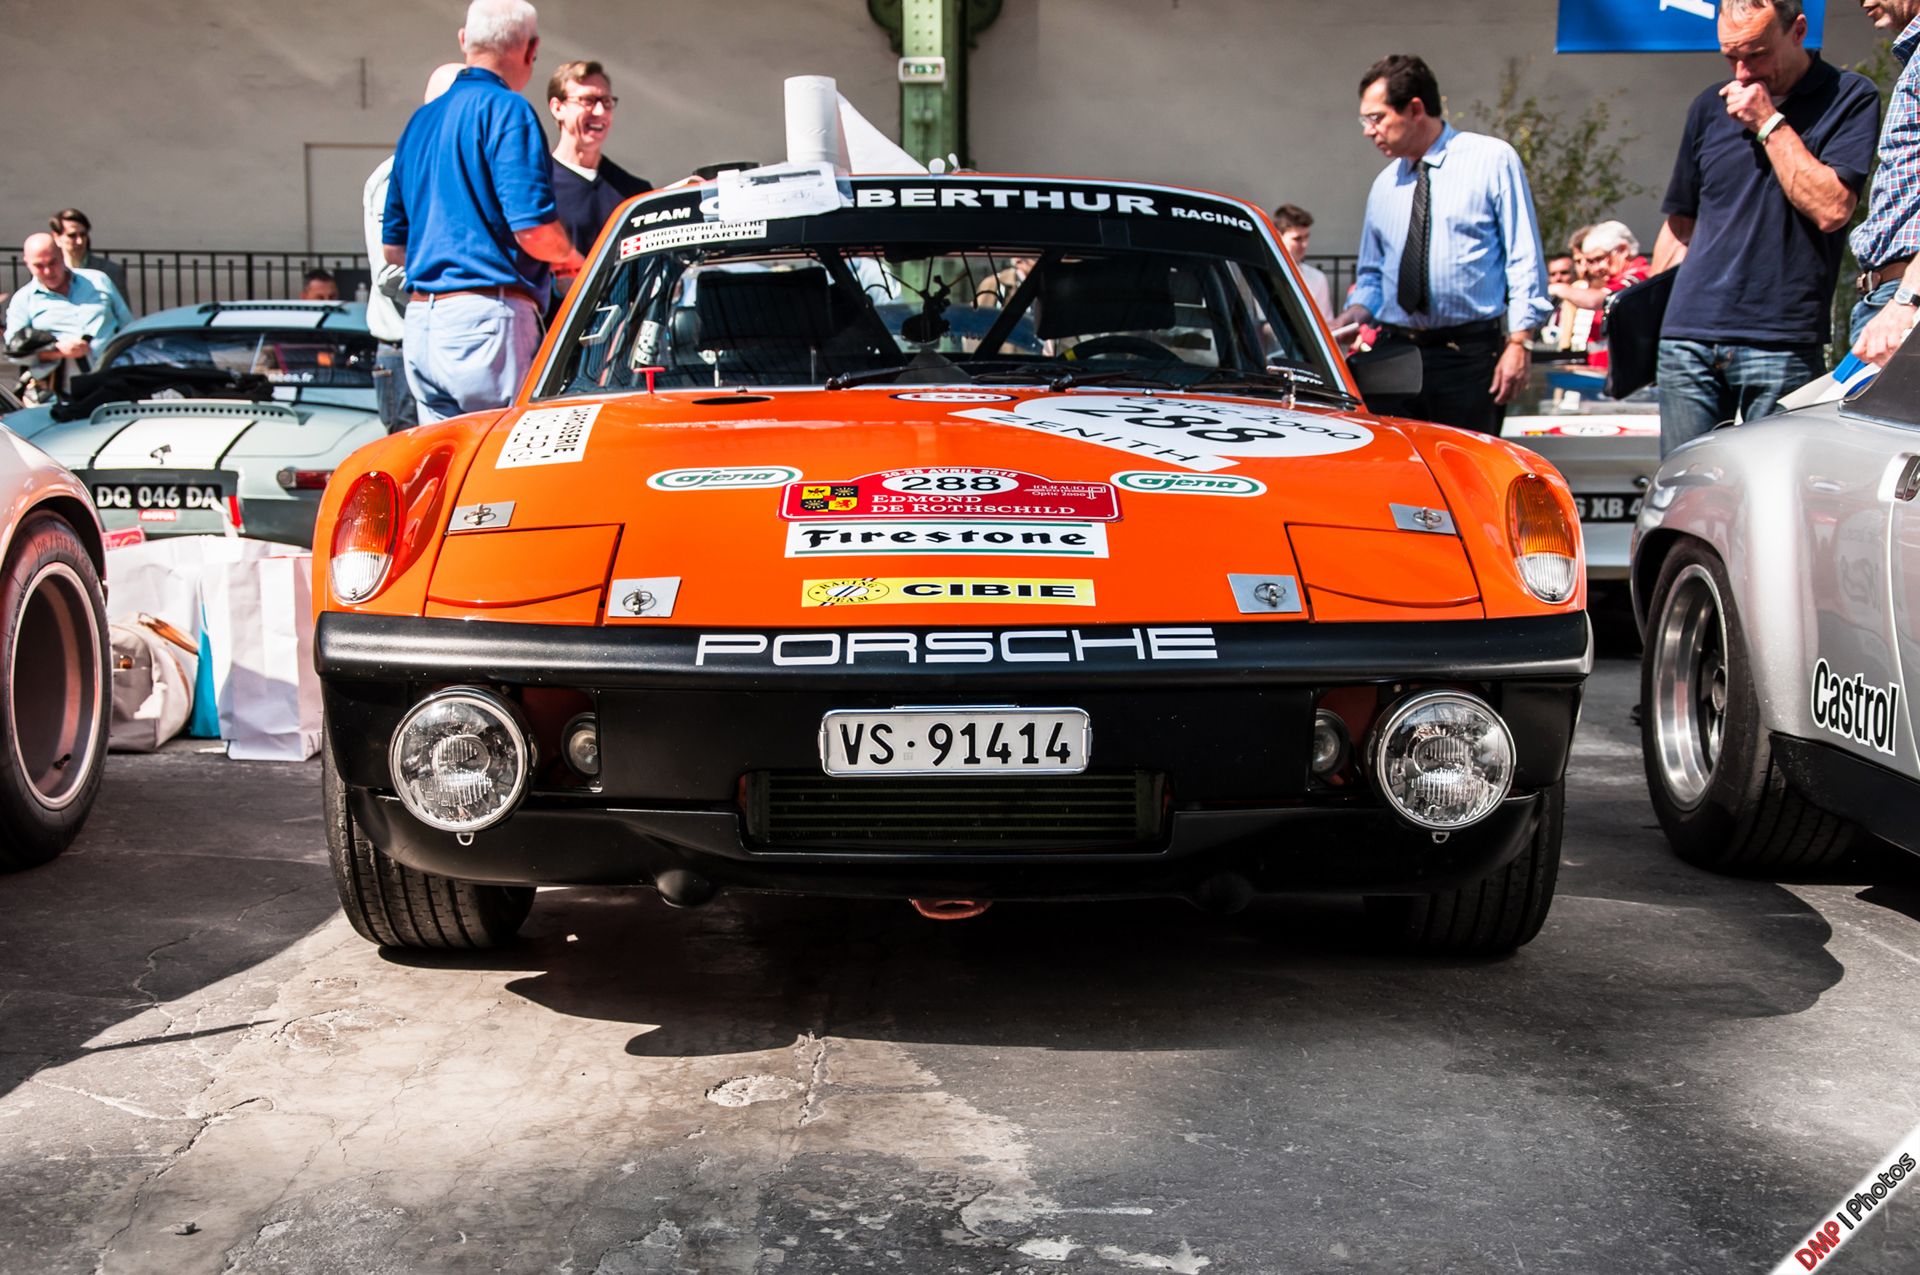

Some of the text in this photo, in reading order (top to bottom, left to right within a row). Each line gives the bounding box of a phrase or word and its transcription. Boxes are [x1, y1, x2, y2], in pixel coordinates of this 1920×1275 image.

[630, 207, 691, 228] TEAM
[1171, 207, 1254, 232] RACING
[645, 223, 714, 240] CHRISTOPHE
[645, 229, 763, 249] DIDIER BARTHE
[1056, 404, 1287, 443] 288
[1240, 414, 1361, 440] 2000
[989, 413, 1199, 462] ZENITH
[901, 476, 1002, 491] 288
[981, 468, 1018, 479] 2015
[97, 485, 218, 509] DQ 046 DA
[872, 494, 982, 504] EDMOND
[870, 503, 1076, 515] DE ROTHSCHILD
[1591, 498, 1624, 518] XB
[801, 529, 1087, 549] Firestone
[902, 583, 1077, 598] CIBIE
[695, 627, 1218, 666] PORSCHE
[1812, 659, 1899, 754] Castrol
[927, 722, 1072, 767] 91414
